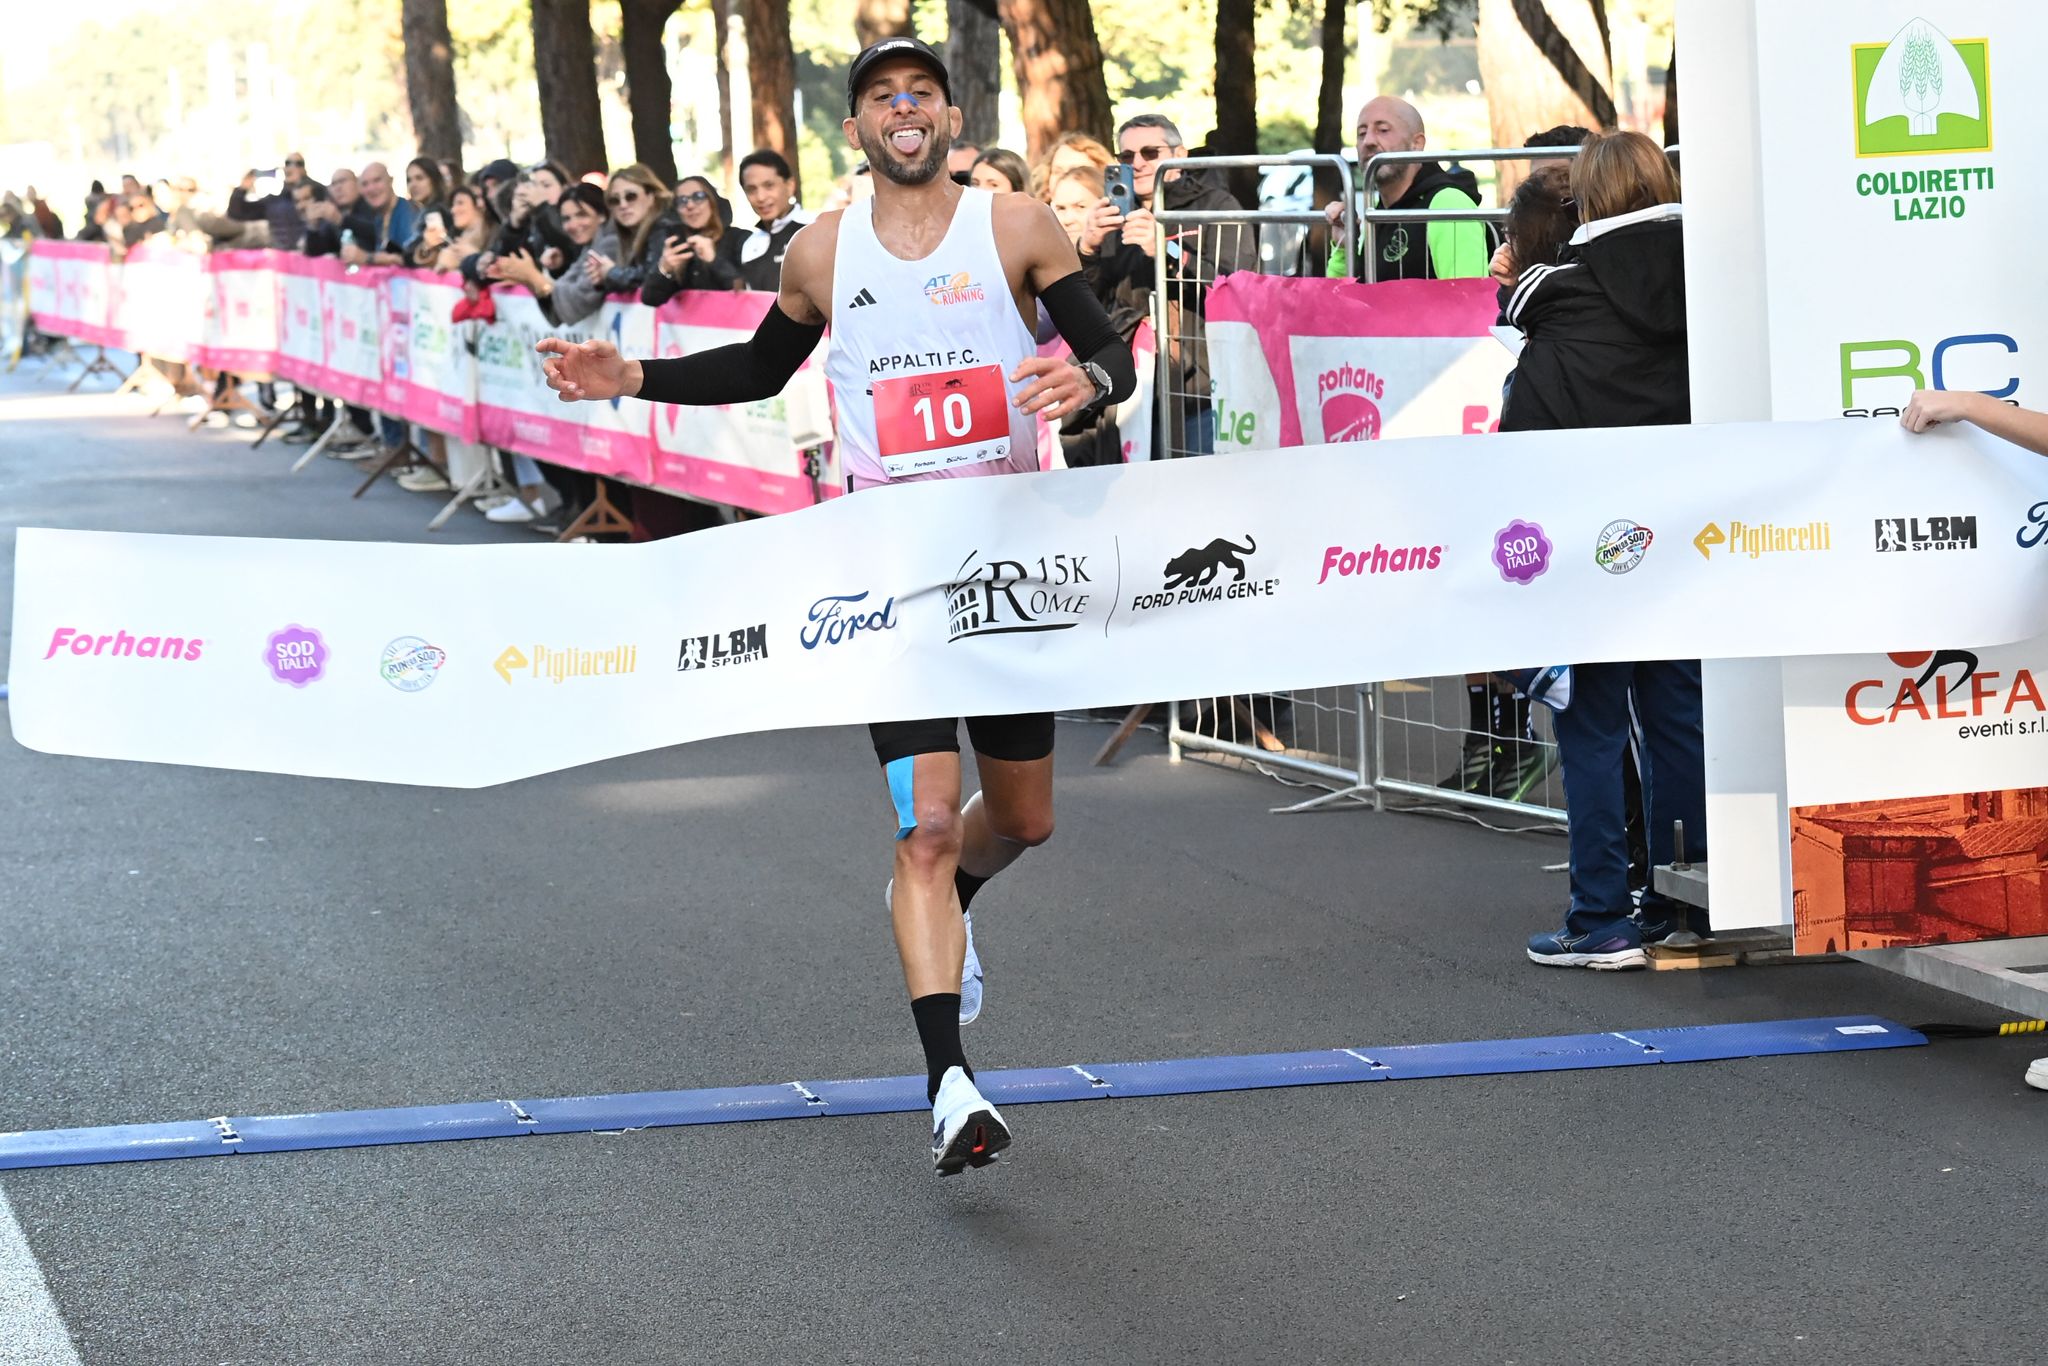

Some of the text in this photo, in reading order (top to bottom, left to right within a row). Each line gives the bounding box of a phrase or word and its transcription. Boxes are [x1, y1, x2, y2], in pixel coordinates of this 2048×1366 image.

[1856, 167, 1995, 197] COLDIRETTI
[1894, 196, 1966, 221] LAZIO
[942, 287, 985, 306] RUNNING
[869, 349, 980, 374] APPALTI F.C.
[913, 393, 973, 442] 10
[1503, 535, 1539, 559] SOD
[1602, 544, 1620, 560] RUN
[1627, 531, 1645, 545] SOD
[1728, 521, 1832, 560] Pigliacelli
[1911, 515, 1978, 550] LBM
[1912, 540, 1969, 552] SPORT
[1035, 553, 1092, 586] 15K
[1317, 543, 1443, 586] Forhans
[1506, 552, 1542, 571] ITALIA
[1132, 591, 1175, 612] FORD
[1177, 585, 1223, 605] PUMA
[800, 590, 898, 651] Ford
[42, 627, 204, 662] Forhans
[275, 640, 316, 659] SOD
[712, 623, 769, 659] LBM
[277, 655, 318, 671] ITALIA
[532, 644, 637, 685] Pigliacelli
[711, 650, 760, 669] SPORT
[1844, 668, 2047, 727] CALFA
[1958, 716, 2048, 740] eventi s.r.l.
